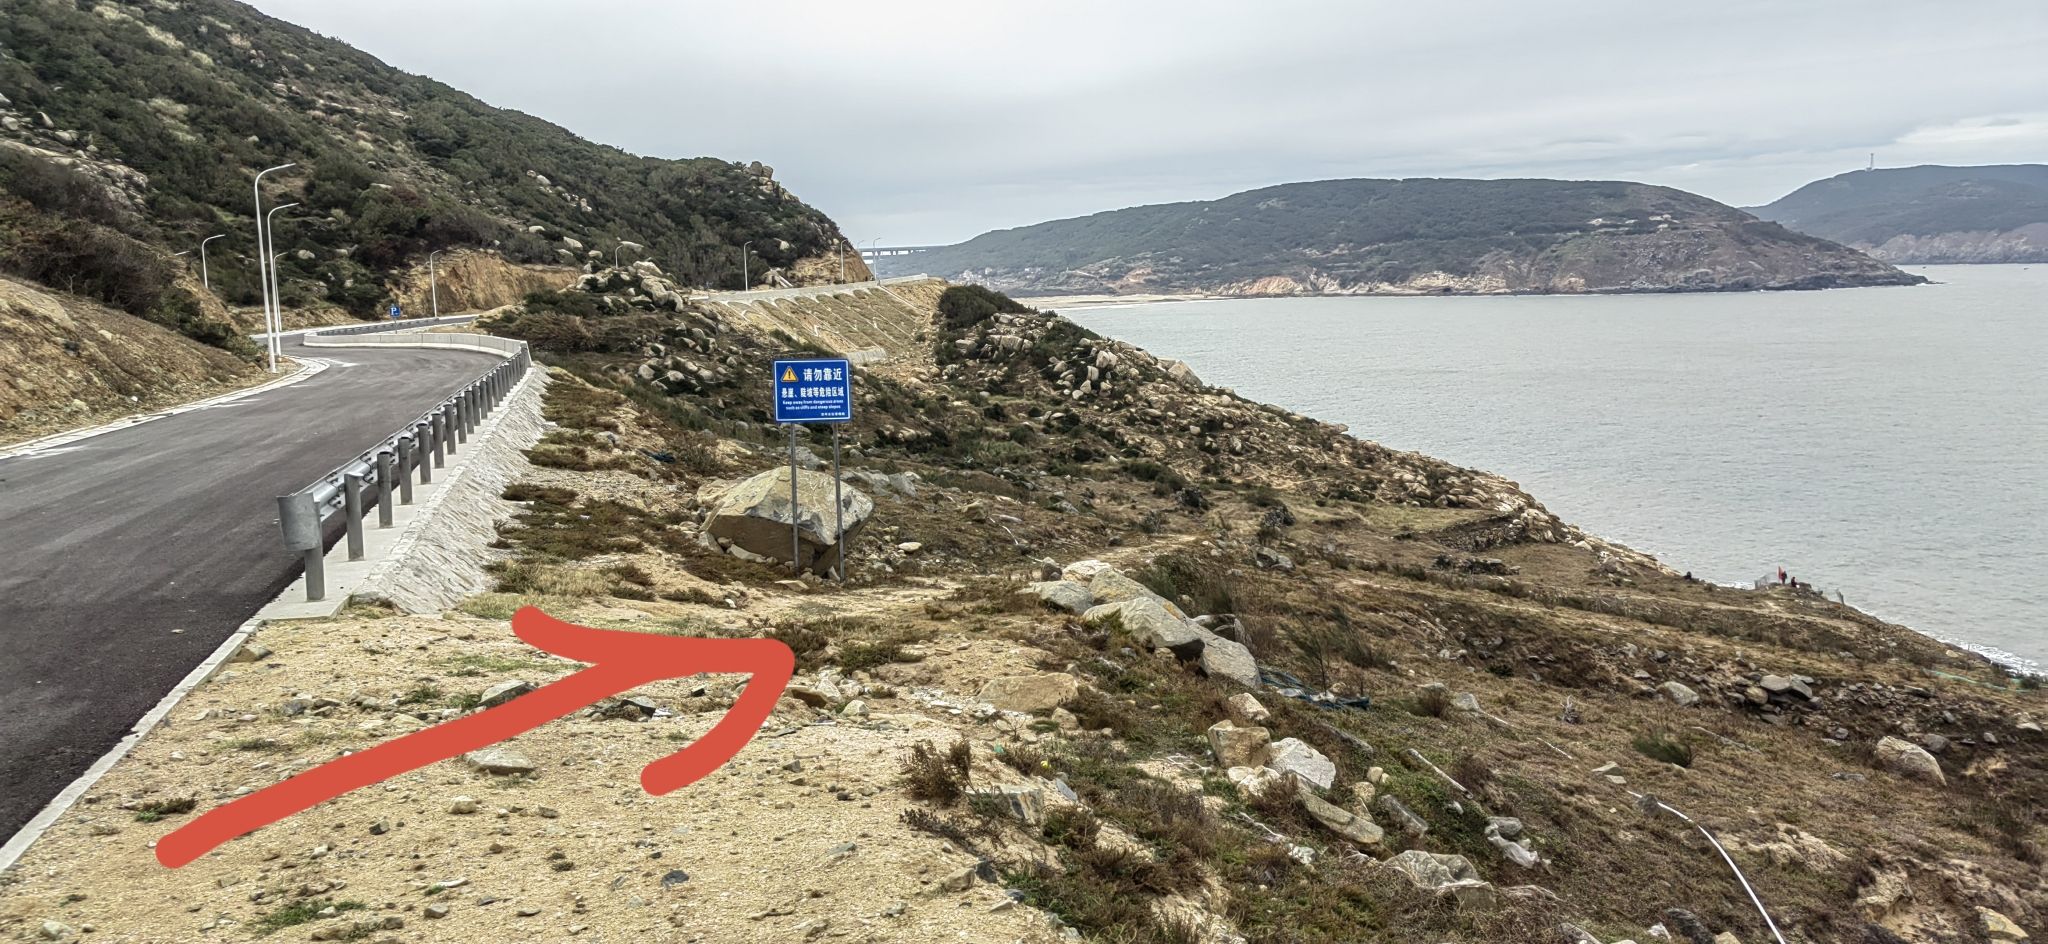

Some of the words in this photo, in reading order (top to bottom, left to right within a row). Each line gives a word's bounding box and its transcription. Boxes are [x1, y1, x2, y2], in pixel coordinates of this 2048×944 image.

[390, 307, 397, 315] P
[803, 368, 843, 381] 请勿靠近
[781, 387, 844, 398] 悬崖、陡坡等危险区域
